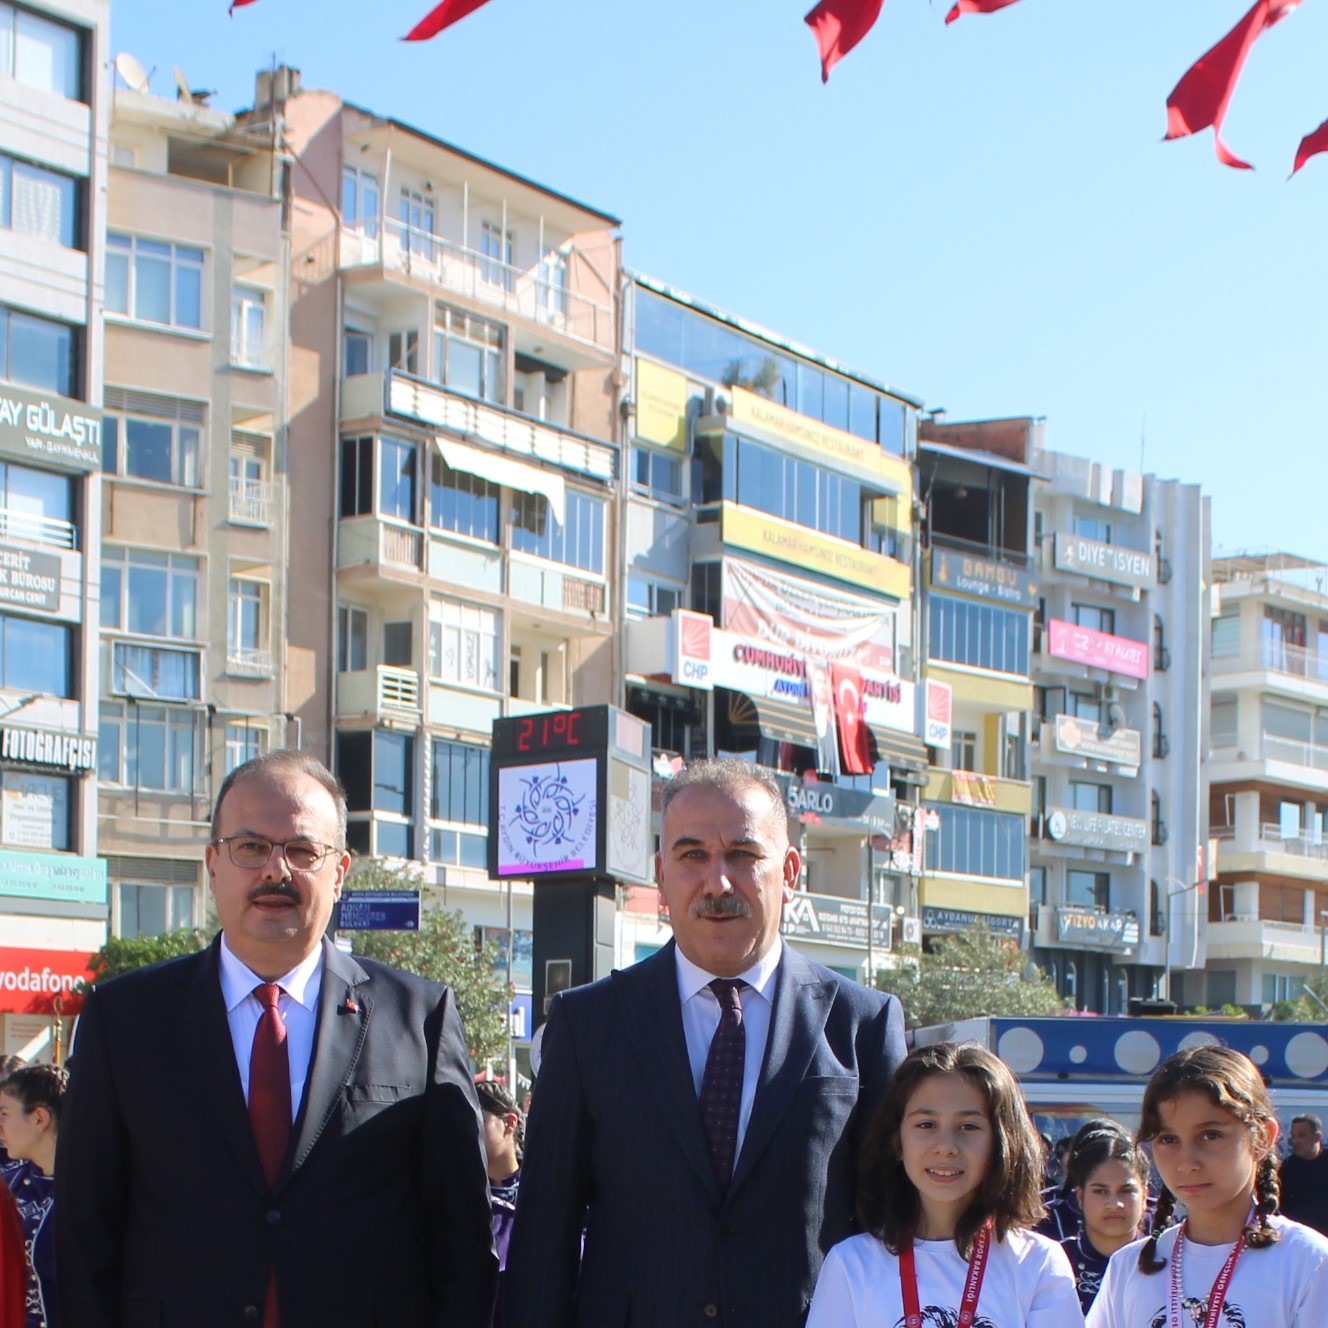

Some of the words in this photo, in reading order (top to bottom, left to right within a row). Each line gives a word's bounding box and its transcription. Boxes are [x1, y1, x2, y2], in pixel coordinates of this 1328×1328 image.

[27, 401, 101, 447] GÜLAŞTI
[683, 661, 708, 680] CHP
[929, 723, 948, 740] CHP
[976, 1240, 987, 1259] SPOR
[966, 1259, 980, 1304] BAKANLIĞI
[1217, 1254, 1236, 1291] GENÇLİK
